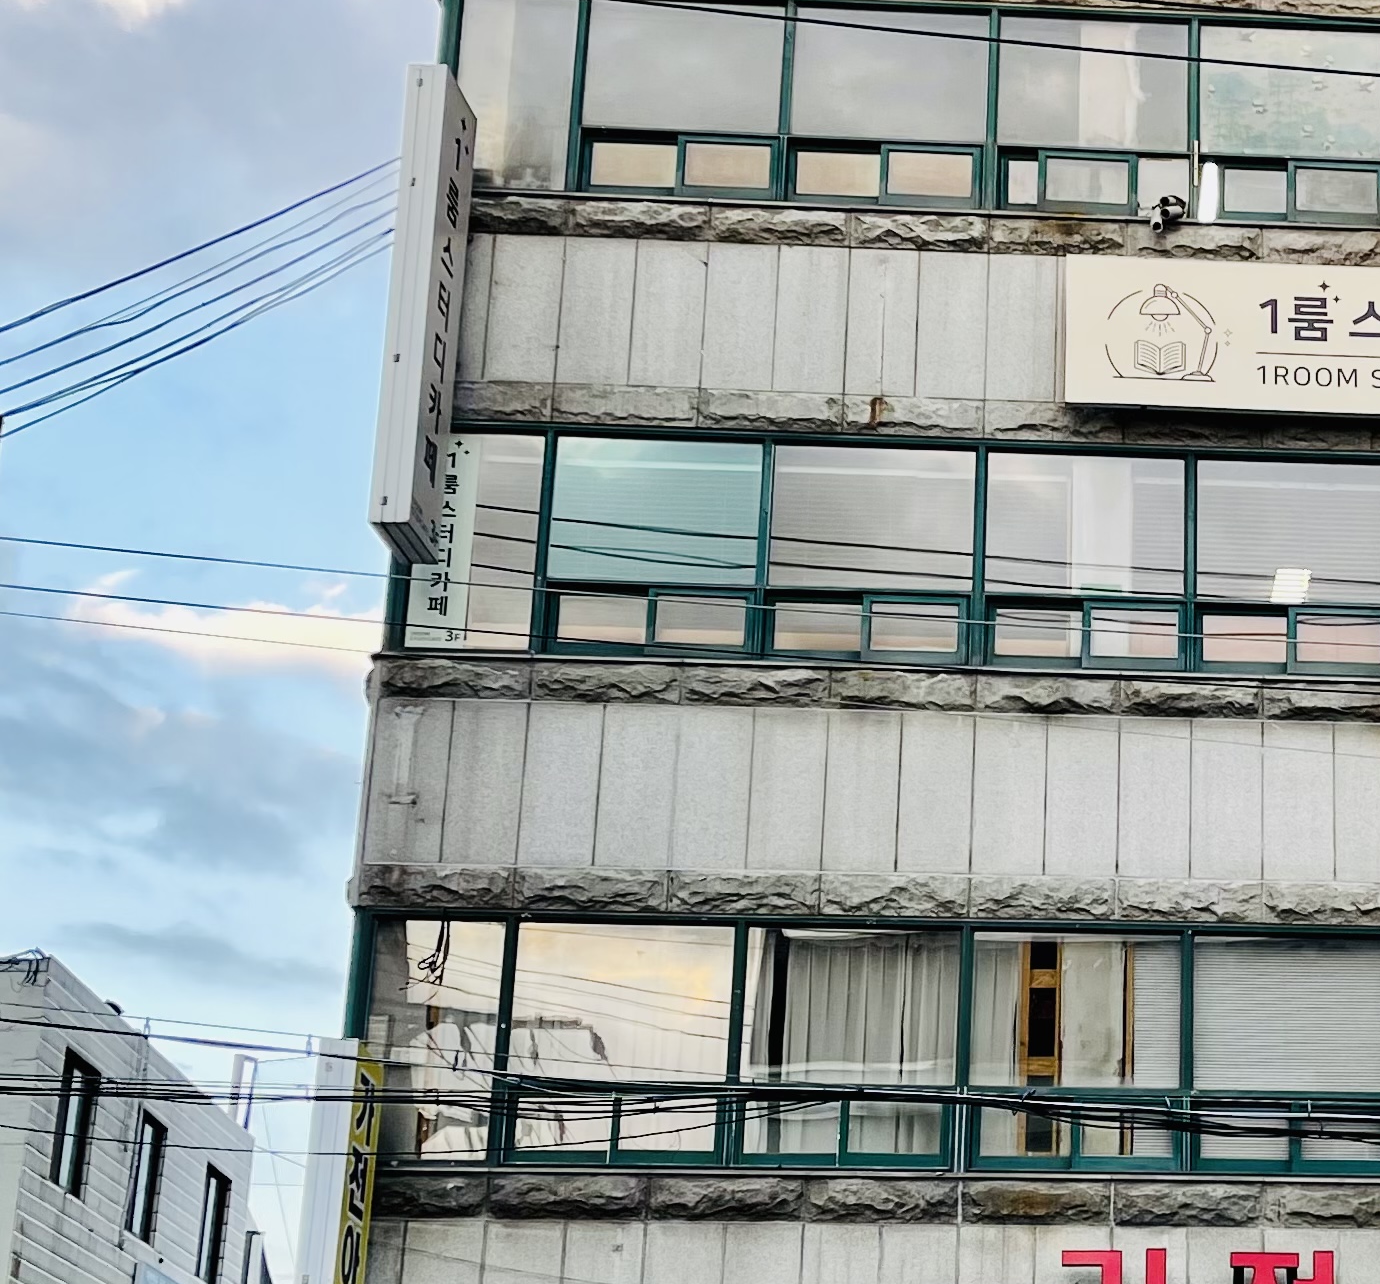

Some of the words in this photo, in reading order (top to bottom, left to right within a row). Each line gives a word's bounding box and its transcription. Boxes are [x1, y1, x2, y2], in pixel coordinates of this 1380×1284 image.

[1258, 295, 1335, 344] 1룸
[1257, 364, 1359, 389] 1ROOM
[444, 630, 461, 643] 3F
